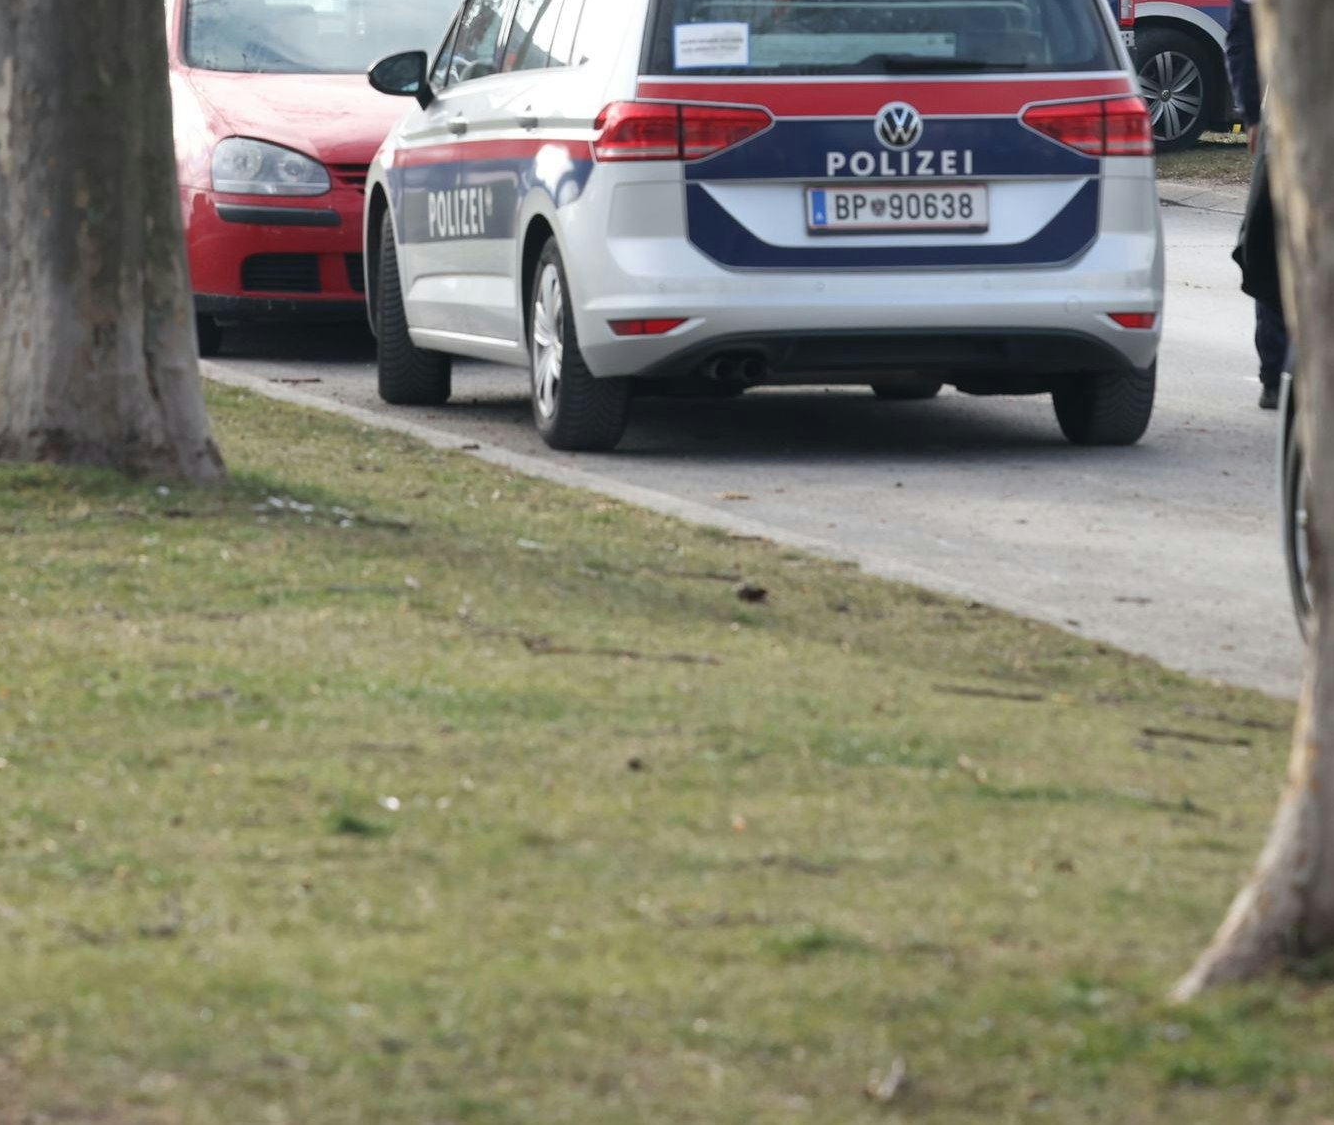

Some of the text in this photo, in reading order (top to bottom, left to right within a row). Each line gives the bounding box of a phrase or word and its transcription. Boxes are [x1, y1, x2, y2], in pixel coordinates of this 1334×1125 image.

[826, 149, 973, 176] POLIZEI
[428, 187, 485, 238] POLIZEI
[835, 193, 973, 220] BP 90638
